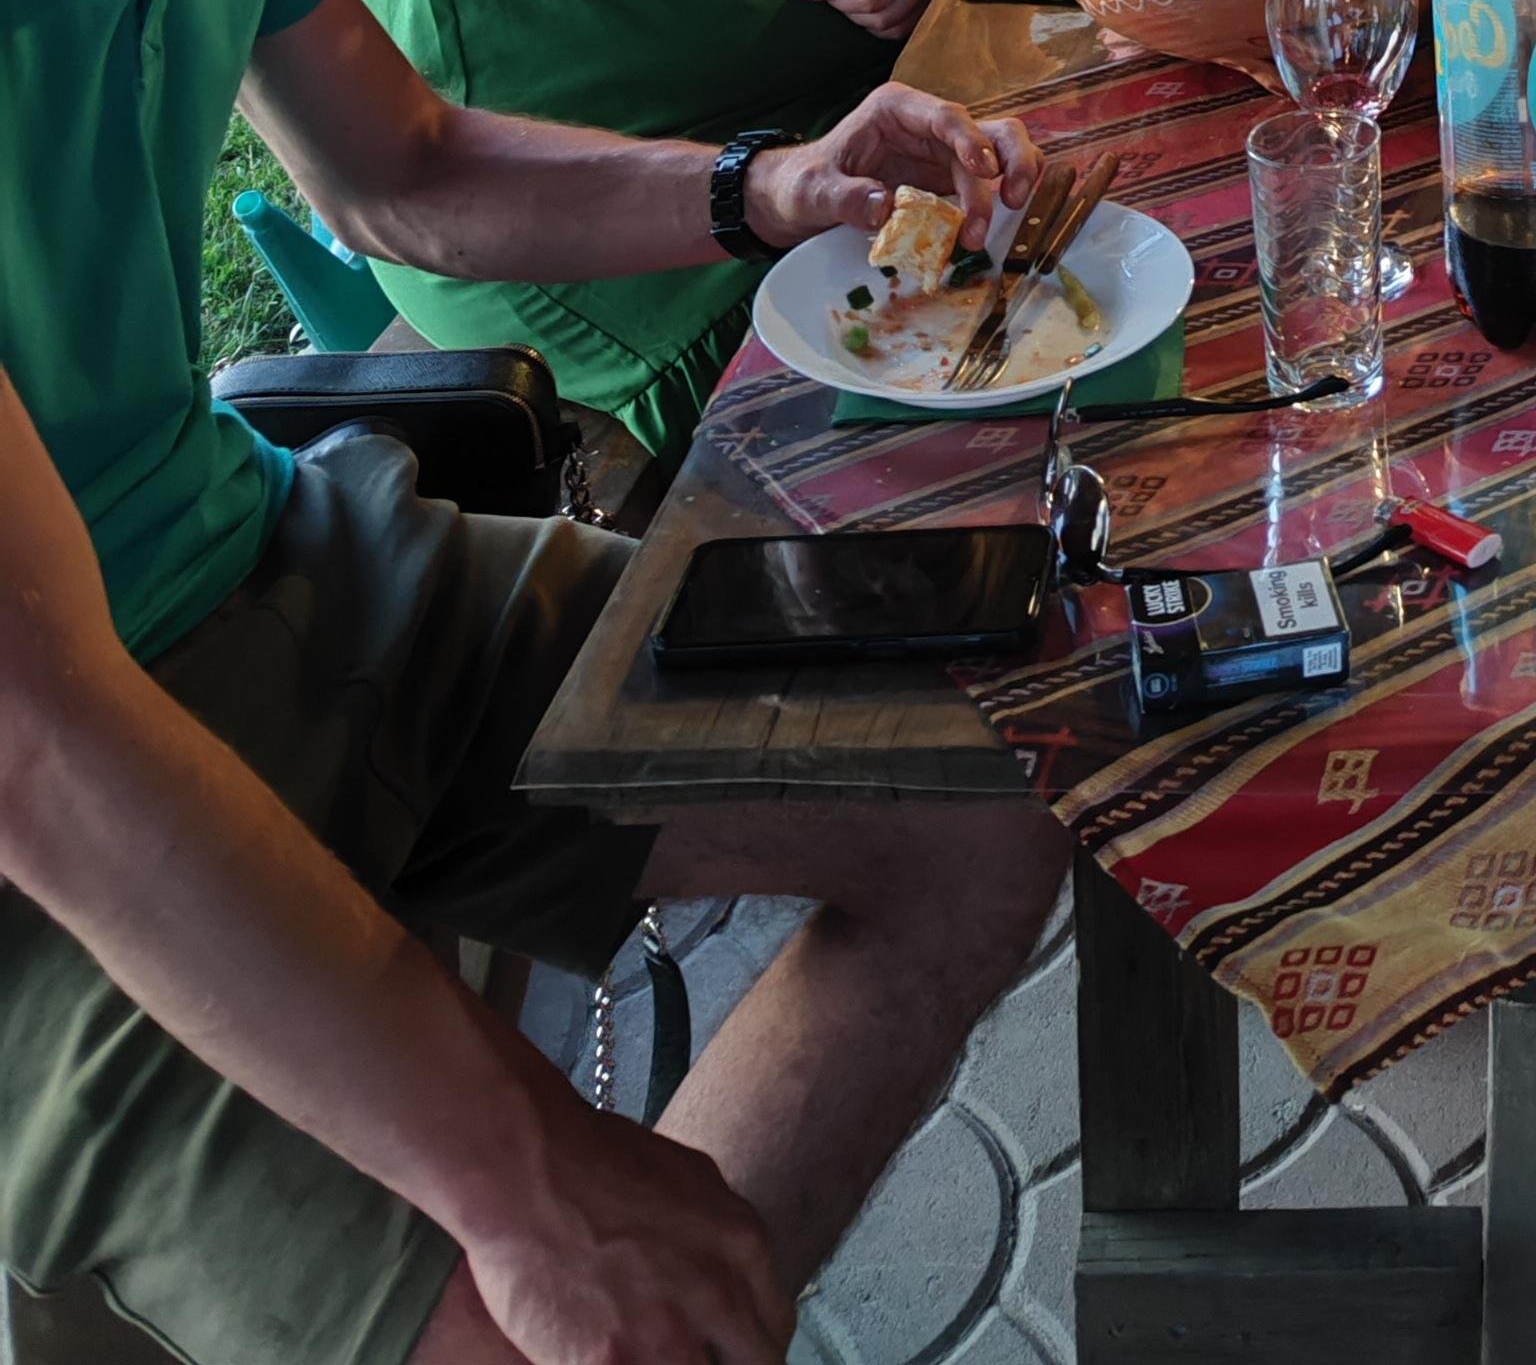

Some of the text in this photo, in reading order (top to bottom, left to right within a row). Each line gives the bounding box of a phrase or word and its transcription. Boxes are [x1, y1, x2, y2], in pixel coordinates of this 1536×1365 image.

[1142, 584, 1166, 616] LUCKY
[1161, 579, 1186, 614] STRIKE
[1268, 570, 1297, 630] Smoking
[1298, 581, 1319, 609] kills
